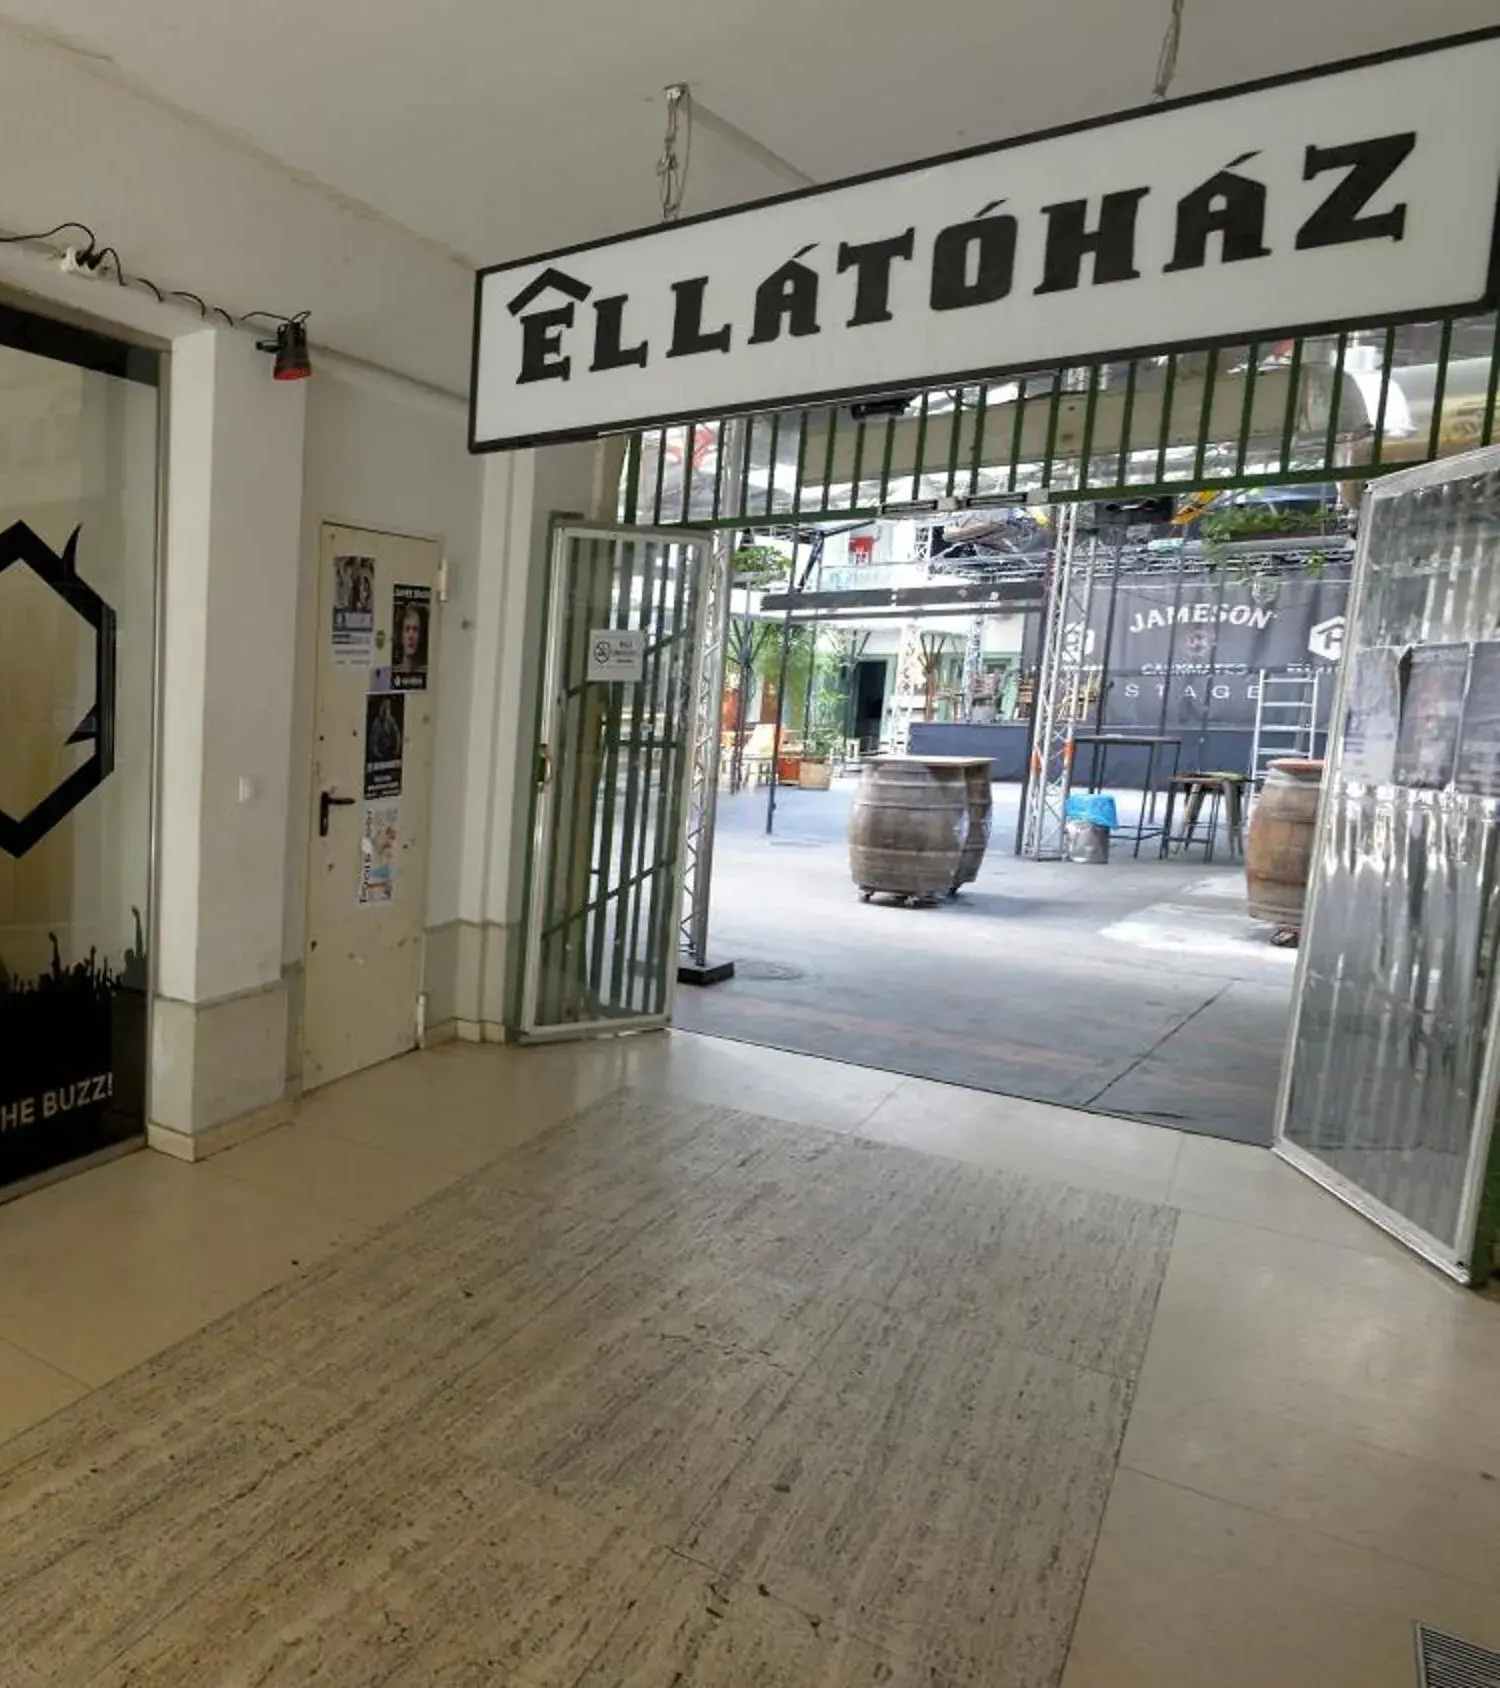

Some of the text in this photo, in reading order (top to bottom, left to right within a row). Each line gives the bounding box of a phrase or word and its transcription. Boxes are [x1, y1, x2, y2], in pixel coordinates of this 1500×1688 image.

[1129, 603, 1274, 633] JAMESON
[1124, 683, 1262, 699] STAGE
[42, 1071, 113, 1118] BUZZ!
